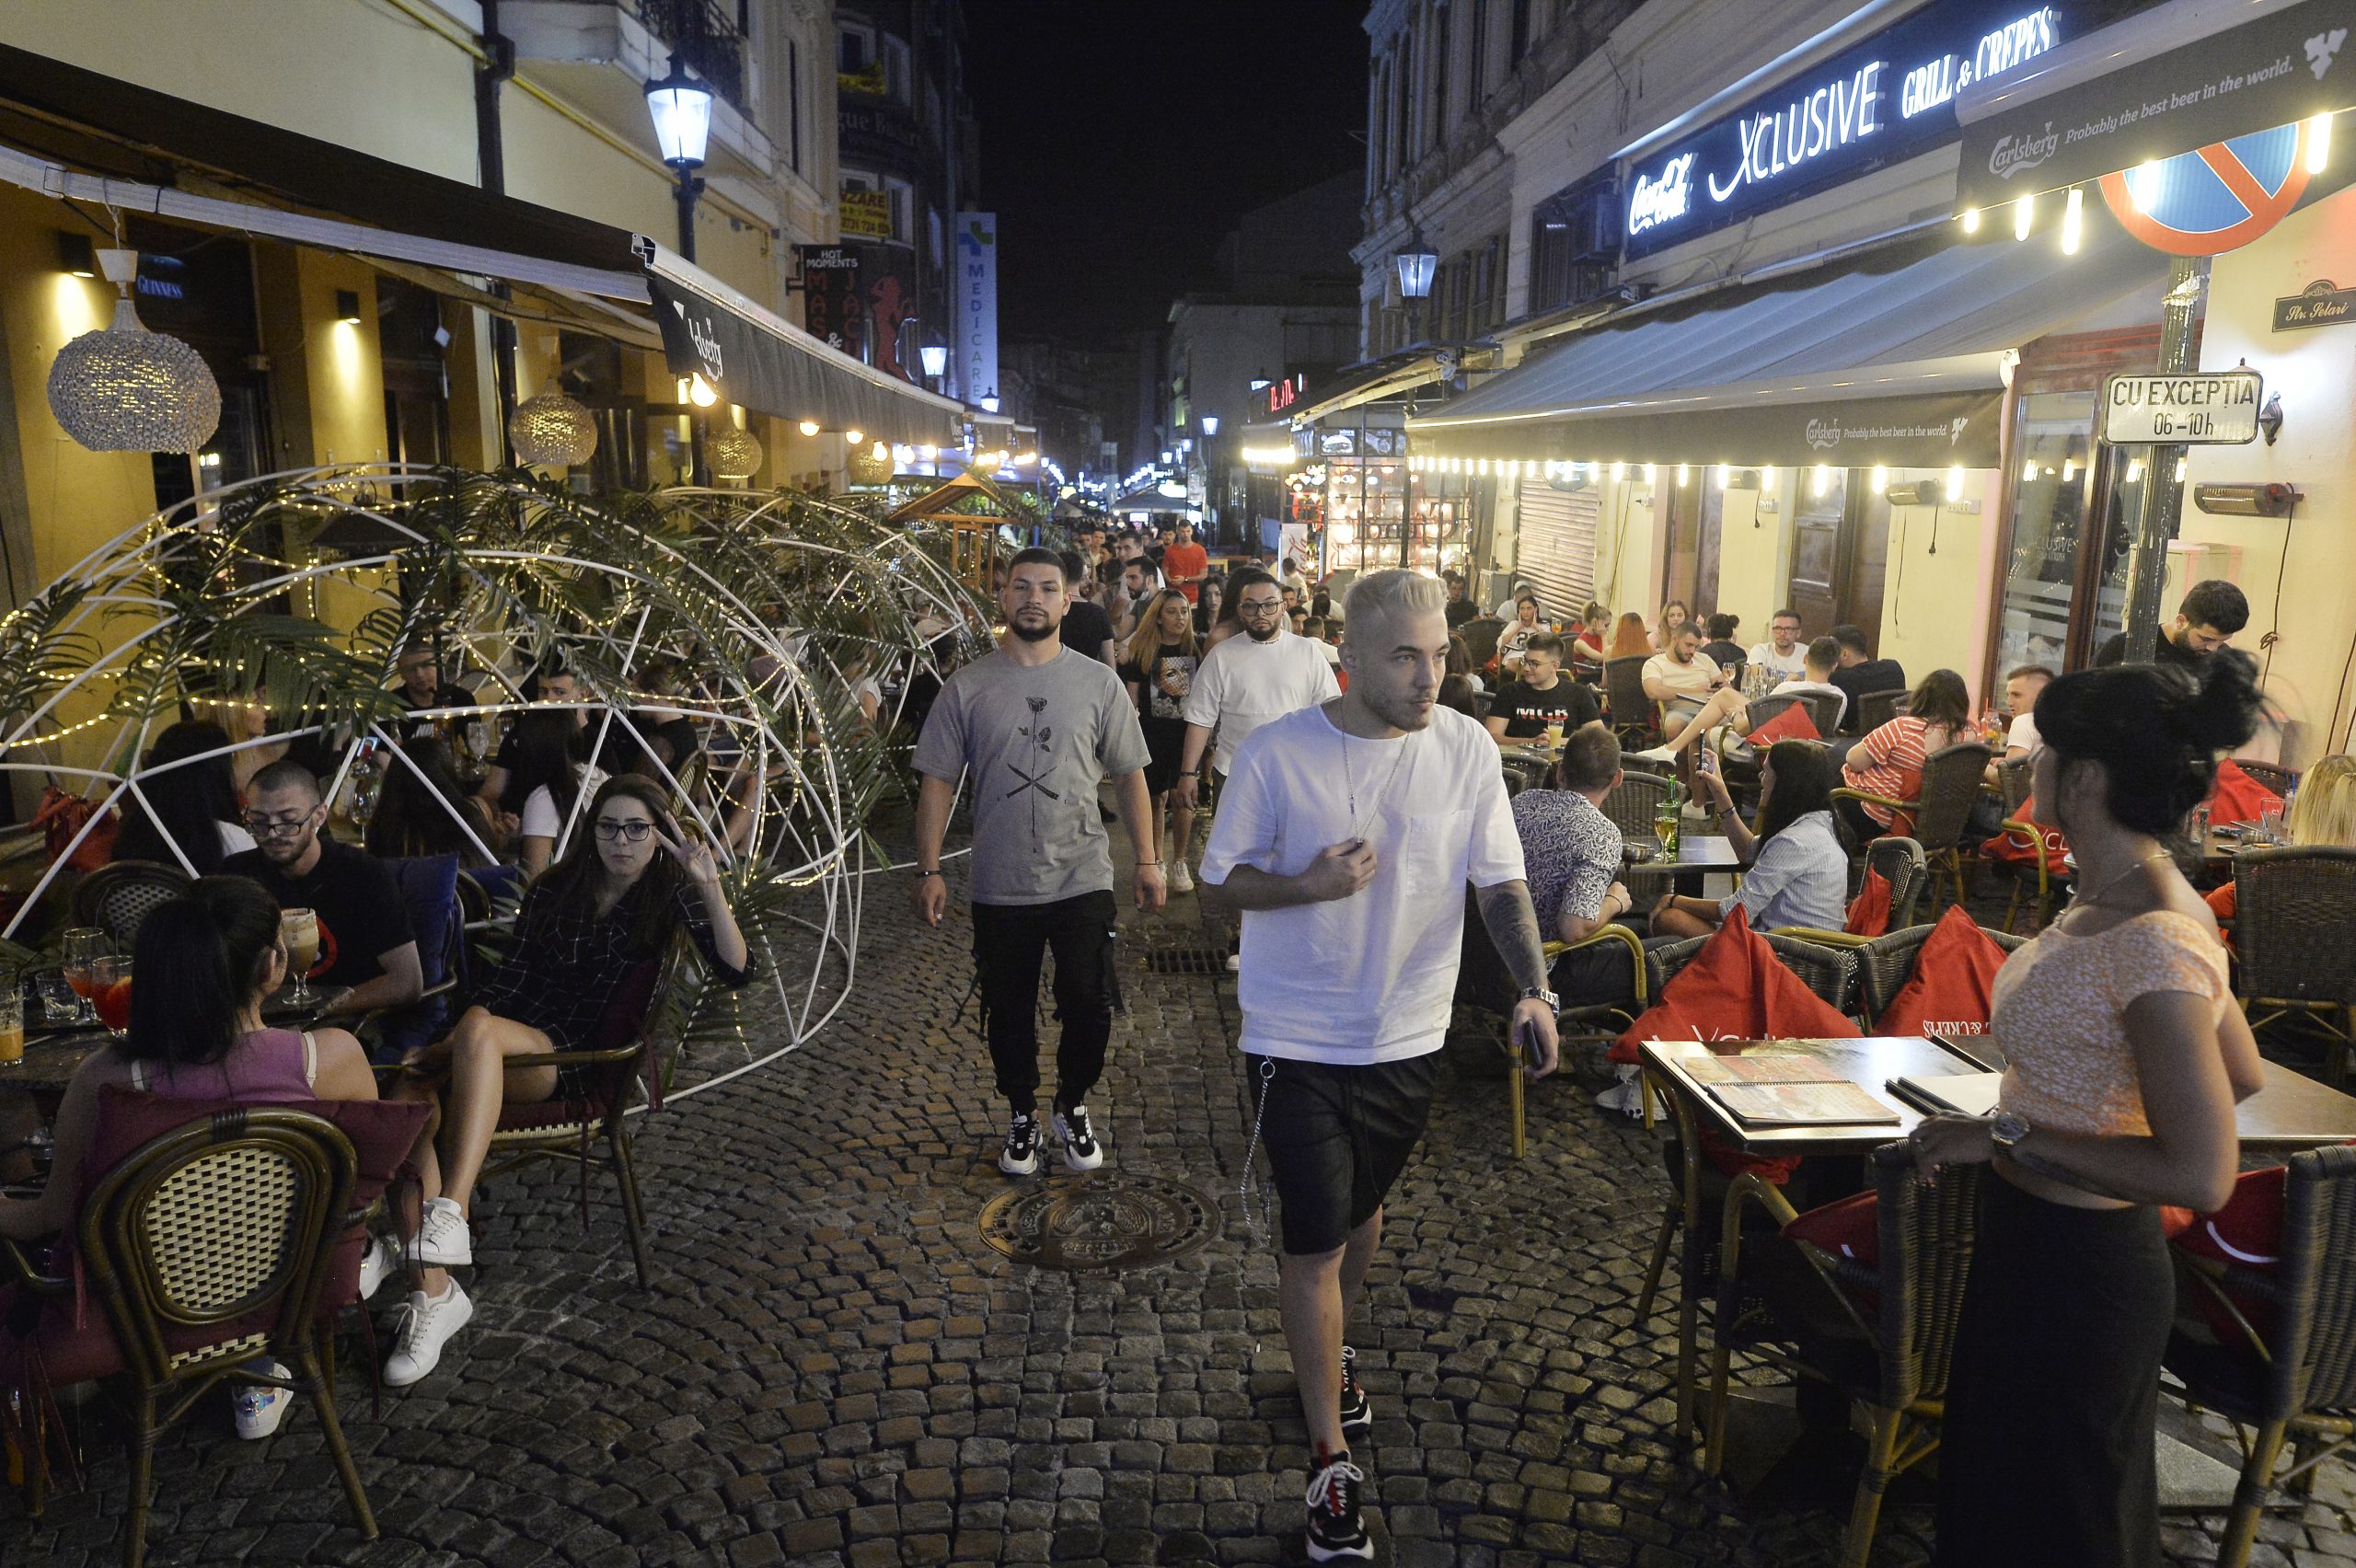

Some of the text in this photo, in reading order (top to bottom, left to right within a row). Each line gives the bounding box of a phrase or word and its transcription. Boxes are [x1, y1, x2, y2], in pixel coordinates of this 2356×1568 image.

[1902, 5, 2053, 119] GRILL & CREPES
[1709, 61, 1880, 202] XCLUSIVE
[1989, 55, 2293, 179] Carlsberg Probably the best beer in the world.
[806, 258, 859, 269] MOMENTS
[821, 249, 842, 259] HOT
[968, 263, 985, 398] MEDICARE
[2113, 380, 2142, 407] CU
[1806, 419, 1842, 451] Carlsberg
[1843, 428, 1869, 441] Probably
[1869, 427, 1879, 438] the
[1879, 427, 1893, 437] best
[1893, 427, 1907, 437] beer
[1908, 426, 1914, 436] in
[1915, 425, 1926, 436] the
